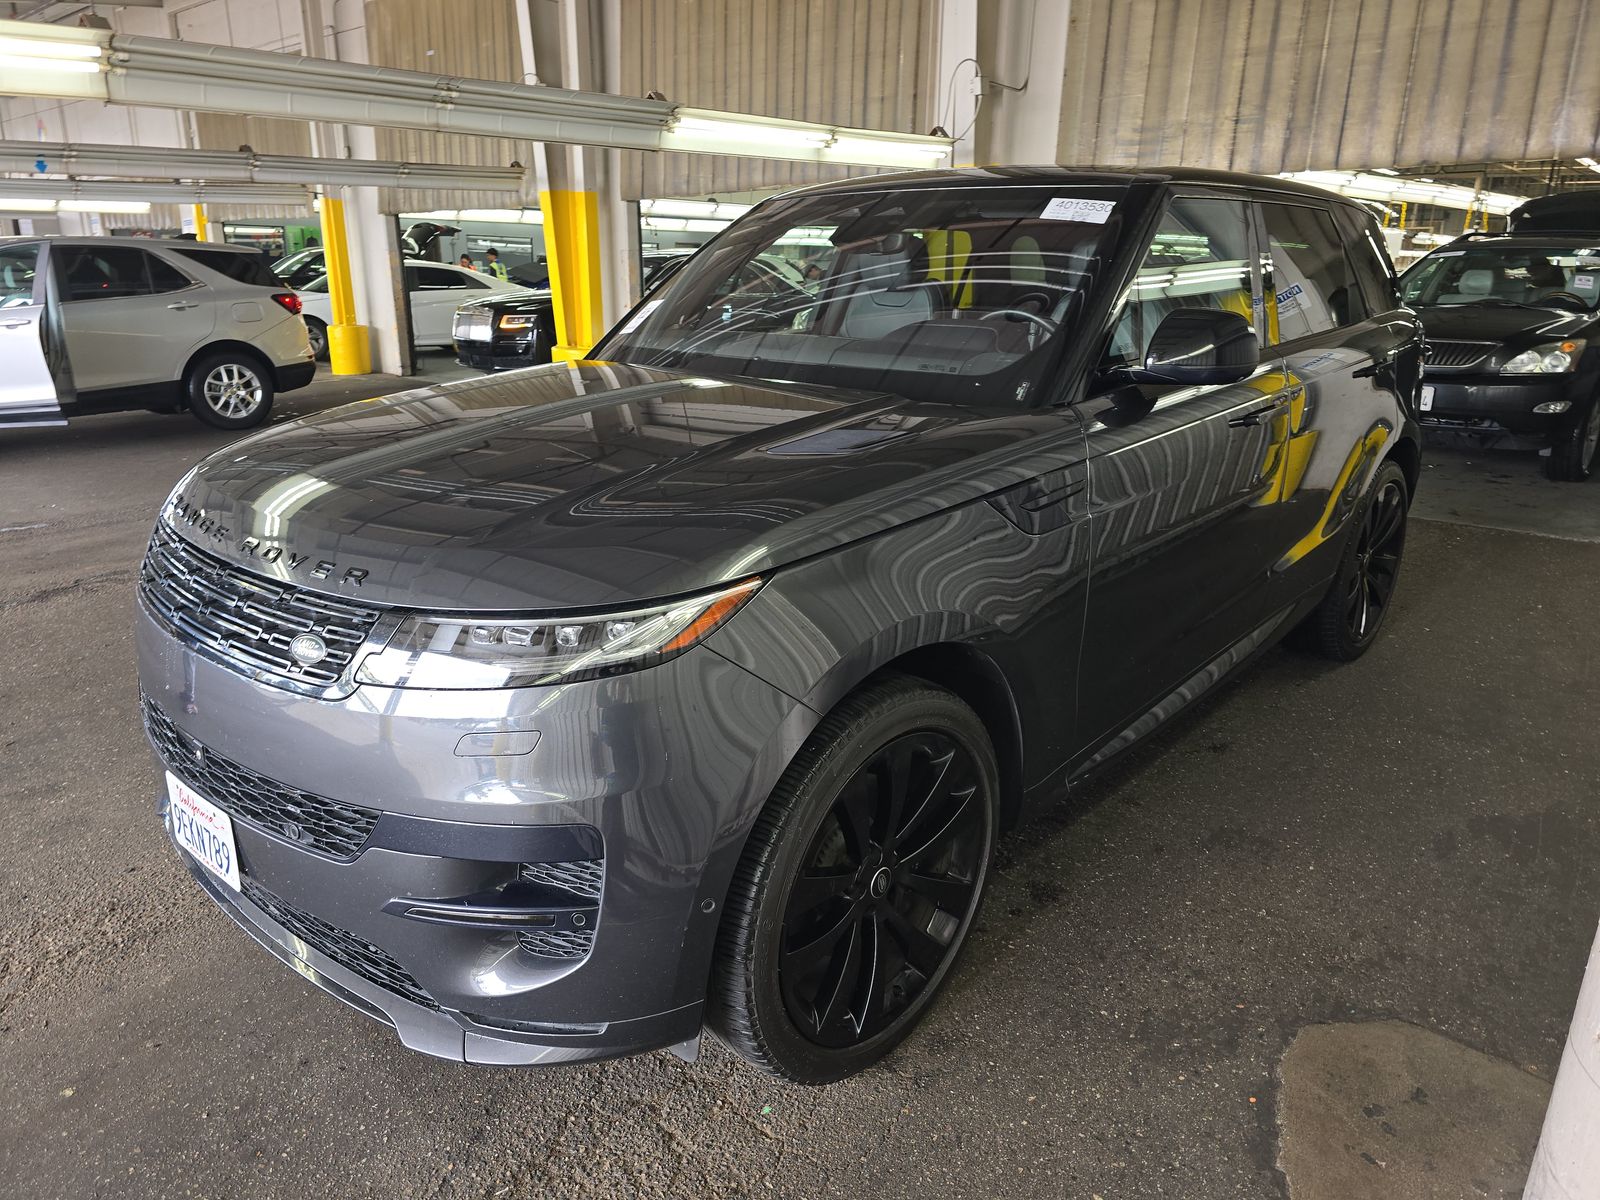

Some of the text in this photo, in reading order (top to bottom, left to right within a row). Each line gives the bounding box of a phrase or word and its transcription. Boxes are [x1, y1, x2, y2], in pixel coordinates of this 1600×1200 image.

[174, 494, 369, 587] RANGE ROVER
[174, 803, 230, 874] 9EKN789
[178, 787, 215, 824] California
